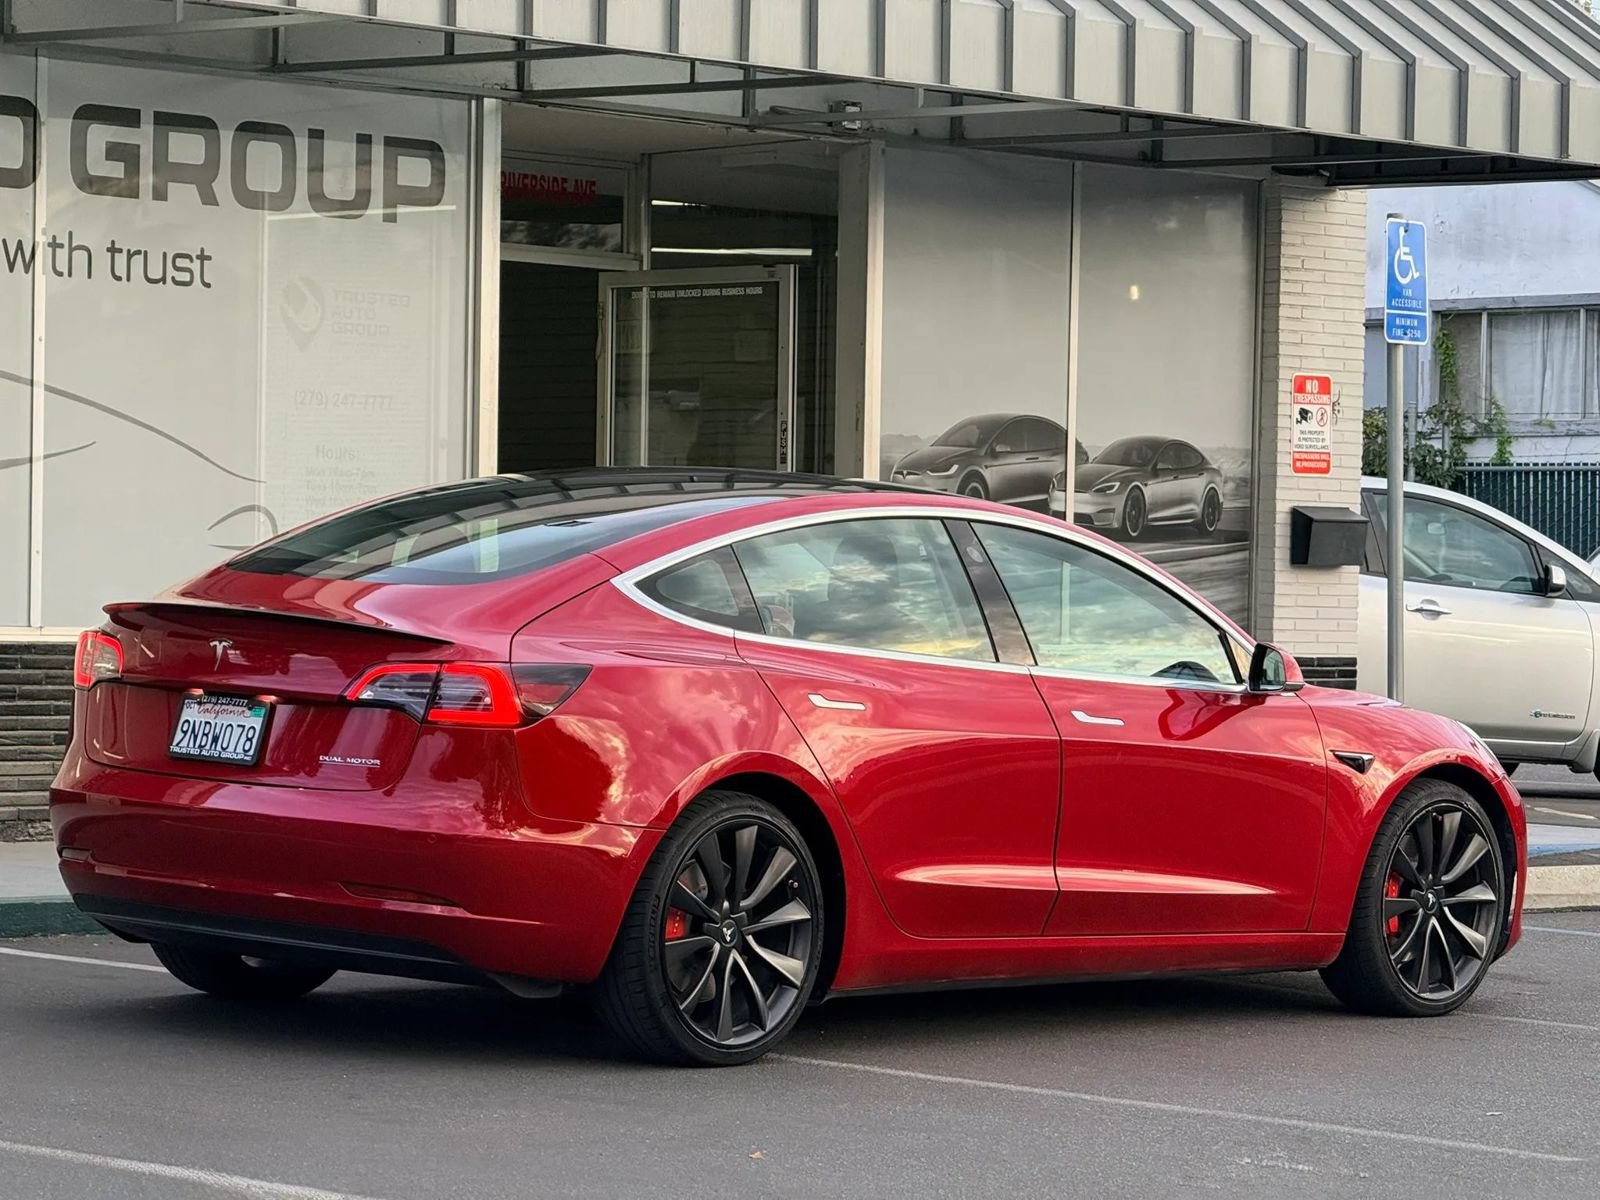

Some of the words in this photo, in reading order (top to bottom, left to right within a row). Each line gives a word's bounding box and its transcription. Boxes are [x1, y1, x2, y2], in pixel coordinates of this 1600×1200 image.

[69, 103, 446, 223] GROUP
[106, 239, 212, 289] trust
[1402, 288, 1412, 297] VAN
[1391, 298, 1422, 308] ACCESSIBLE
[1395, 317, 1418, 327] MINIMUM
[1392, 327, 1404, 337] FINE
[1305, 379, 1319, 394] NO
[197, 702, 251, 719] California
[176, 719, 256, 753] 9NBW078
[169, 745, 200, 755] TRUSTED
[200, 749, 220, 757] AUTO
[220, 751, 244, 760] GROUP
[319, 755, 345, 763] DUAL
[346, 757, 381, 766] MOTOR
